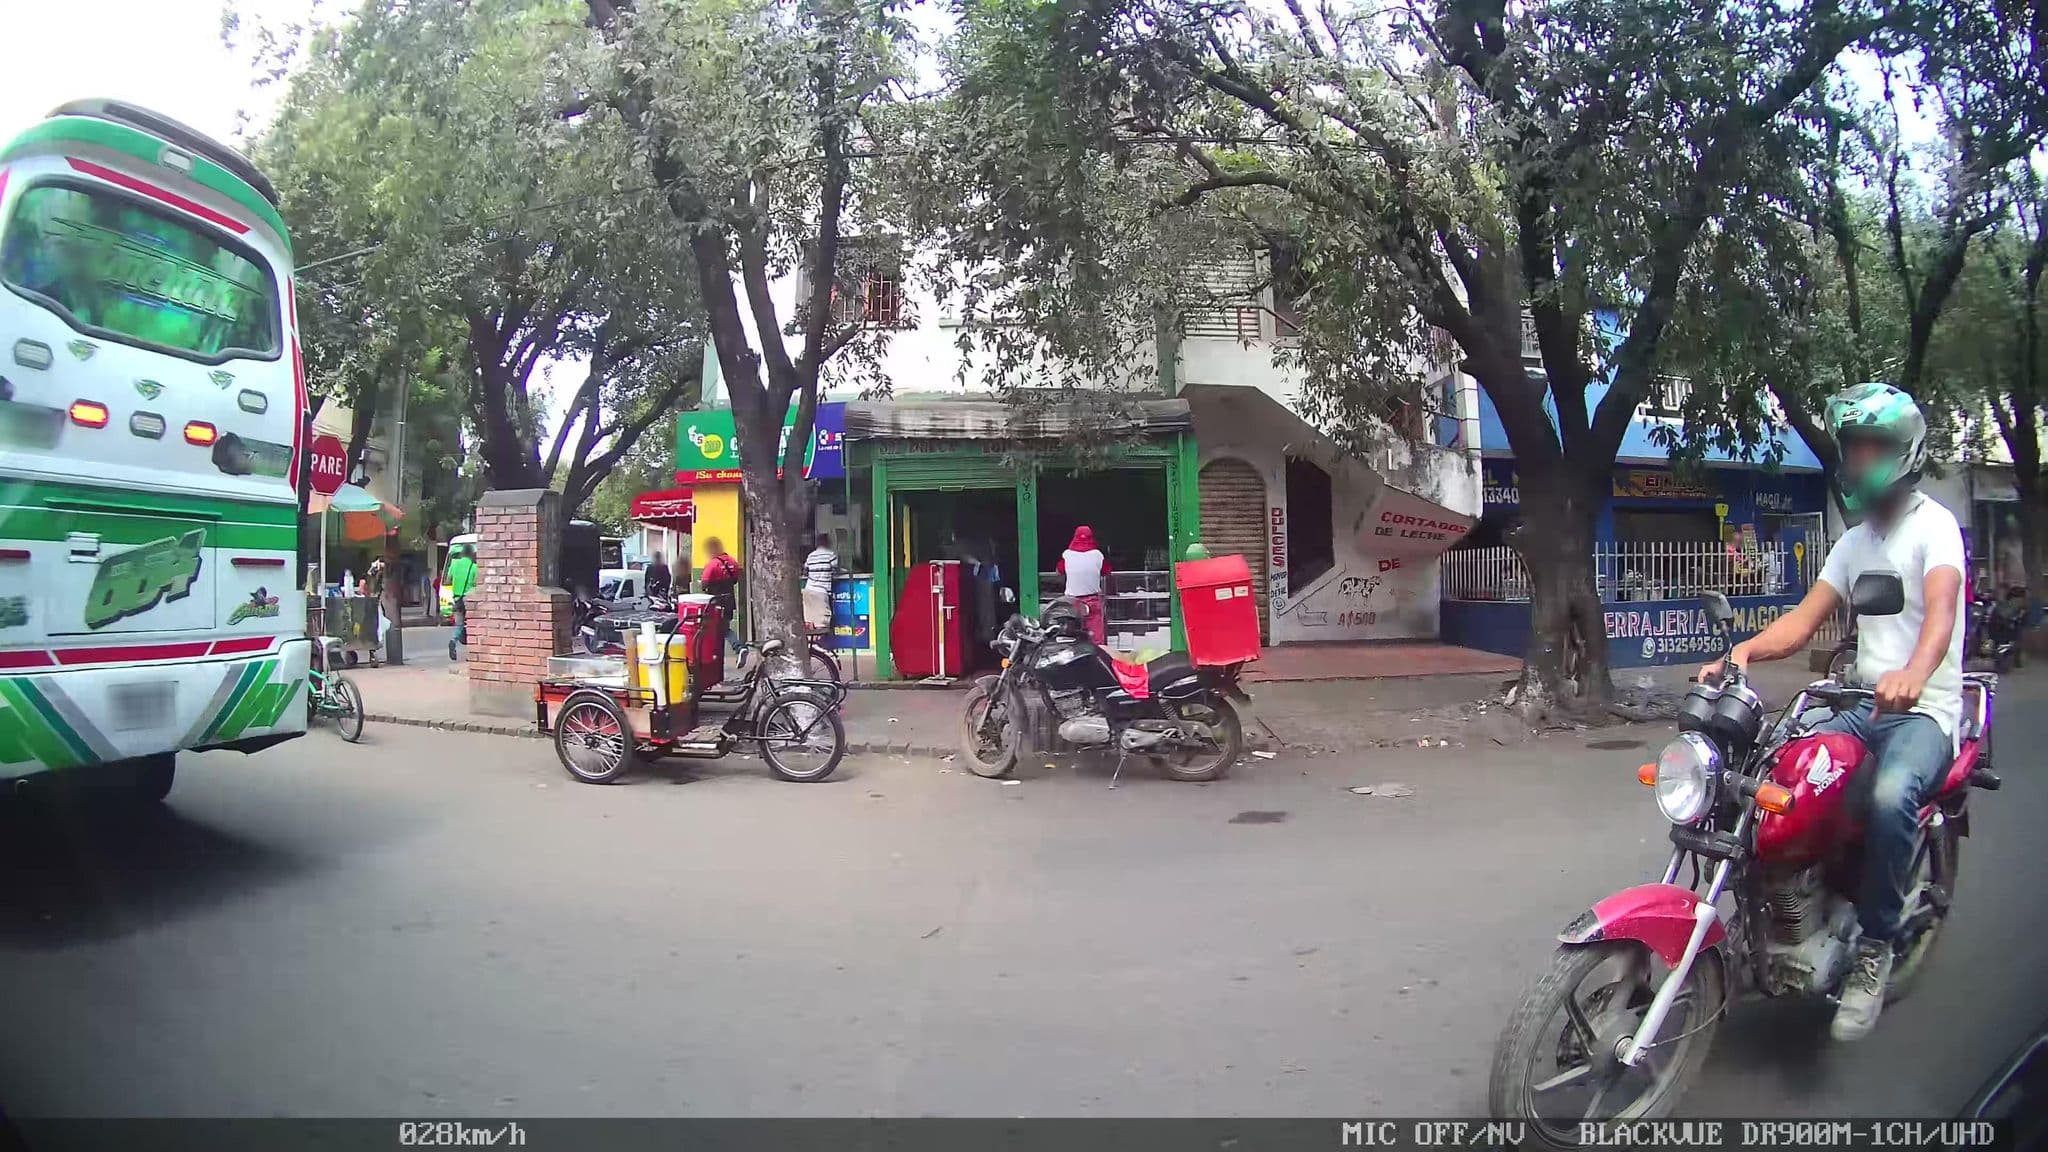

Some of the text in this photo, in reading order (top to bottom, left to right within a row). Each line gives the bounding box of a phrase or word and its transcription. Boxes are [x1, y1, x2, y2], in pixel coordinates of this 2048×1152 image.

[311, 453, 343, 476] PARE
[1375, 526, 1446, 541] DE LECHE
[1381, 511, 1468, 534] CORTADOS
[1271, 507, 1285, 567] DULCES
[1378, 558, 1401, 573] DE
[1603, 609, 1709, 639] ERRAJERIA
[1813, 766, 1847, 797] HONDA
